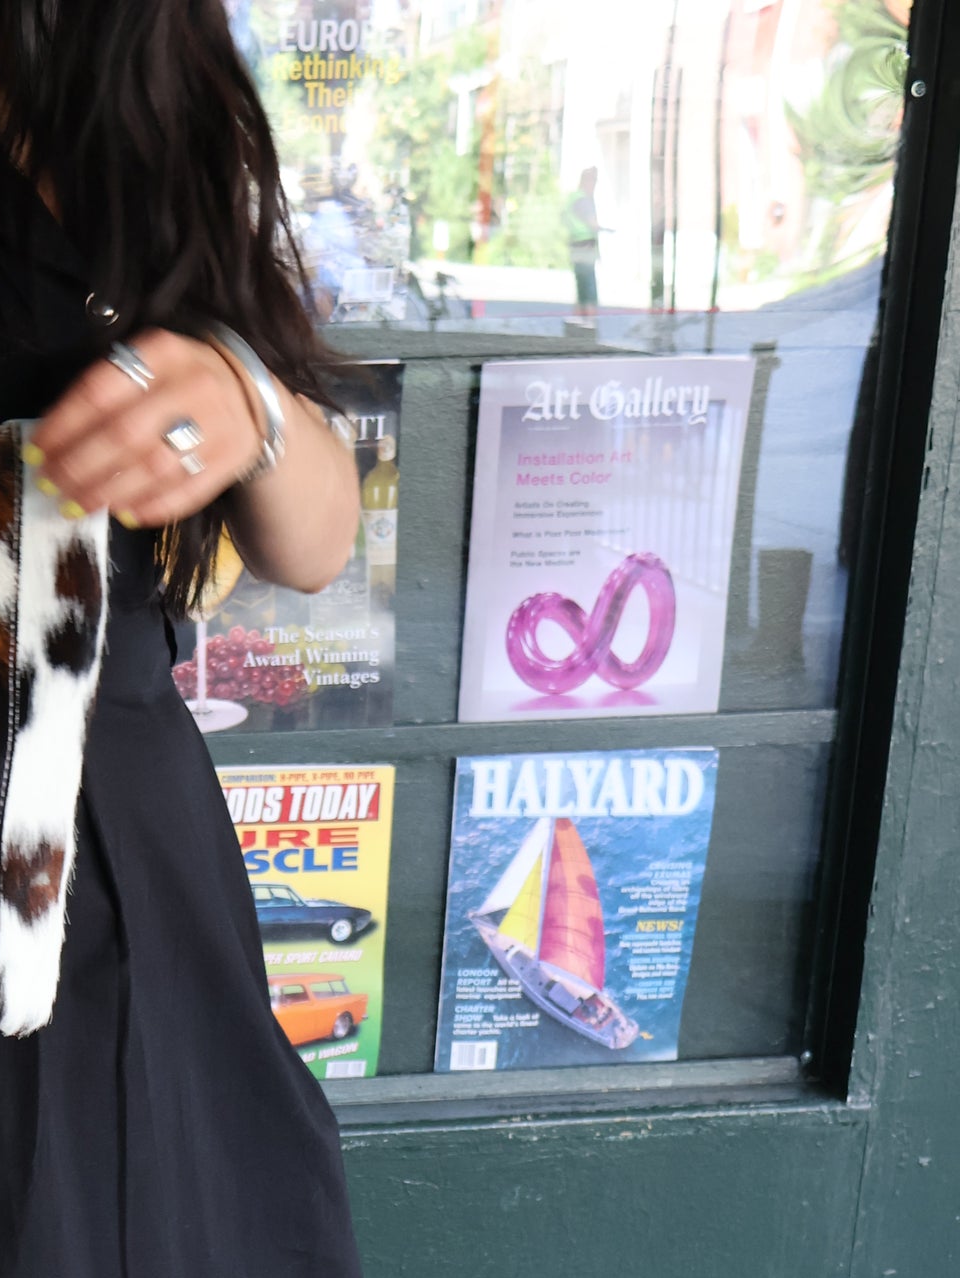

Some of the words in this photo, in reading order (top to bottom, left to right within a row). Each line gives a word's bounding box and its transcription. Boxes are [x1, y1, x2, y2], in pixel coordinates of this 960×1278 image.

[280, 20, 396, 52] EUROP
[305, 82, 364, 108] Thei
[521, 381, 583, 422] Art
[589, 376, 710, 426] Gallery
[517, 450, 605, 467] Installation
[610, 449, 632, 465] Art
[515, 472, 565, 487] Meets
[569, 470, 612, 486] Color
[265, 626, 299, 645] The
[243, 648, 301, 668] Award
[306, 645, 380, 666] Winning
[302, 668, 381, 689] Vintages
[469, 757, 705, 818] HALYARD
[223, 786, 285, 823] ODS
[288, 783, 377, 822] TODAY
[635, 920, 685, 933] NEWS!
[456, 978, 493, 987] REPORT
[457, 968, 499, 978] LONDON
[454, 1004, 496, 1014] CHARTER
